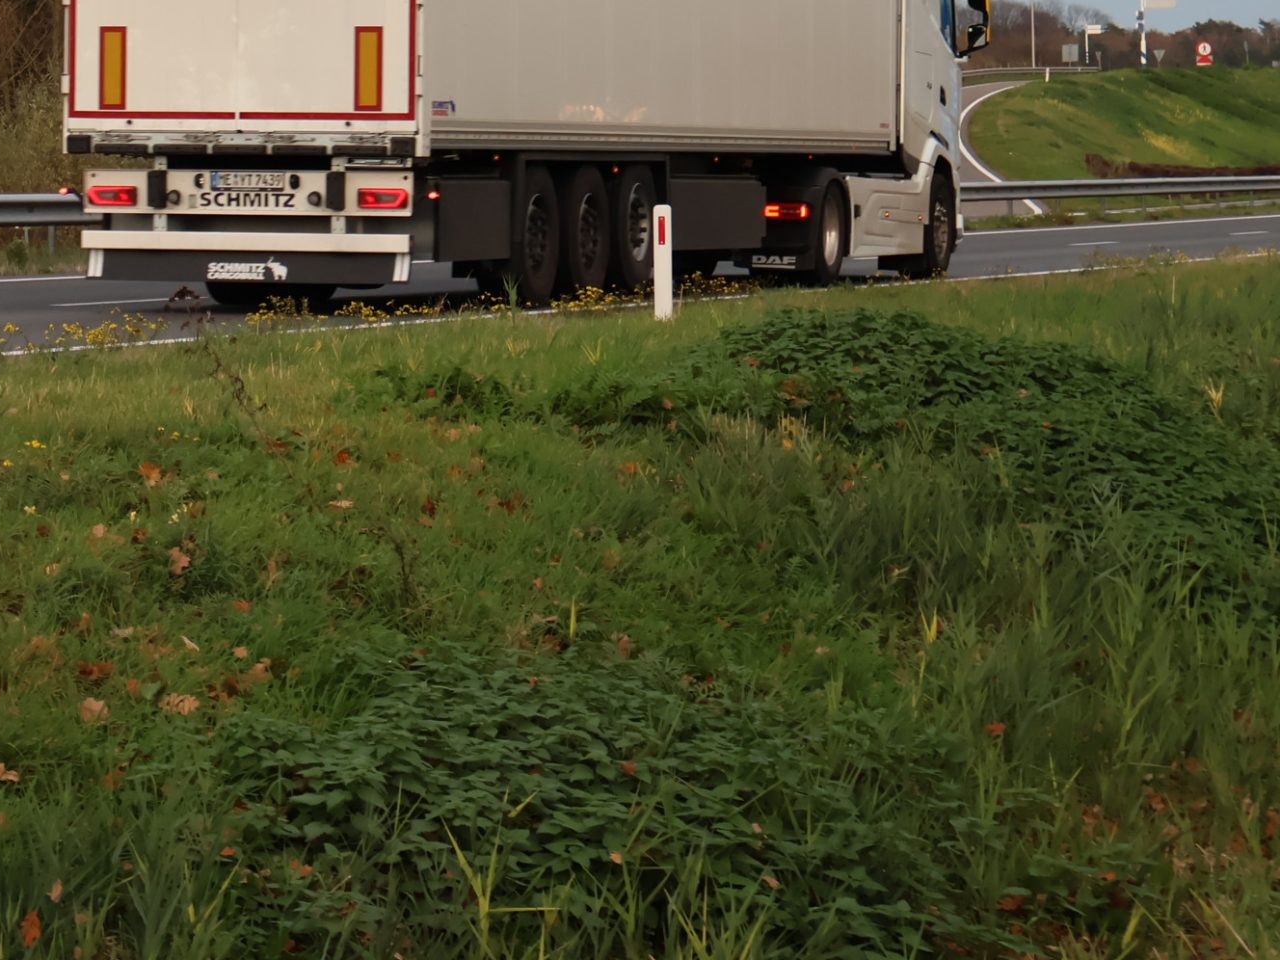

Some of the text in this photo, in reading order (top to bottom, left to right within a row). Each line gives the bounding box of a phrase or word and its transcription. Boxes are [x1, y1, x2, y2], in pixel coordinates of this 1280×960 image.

[200, 192, 296, 208] SCHMITZ
[751, 255, 797, 265] DAF
[207, 262, 266, 272] SCHMITZ
